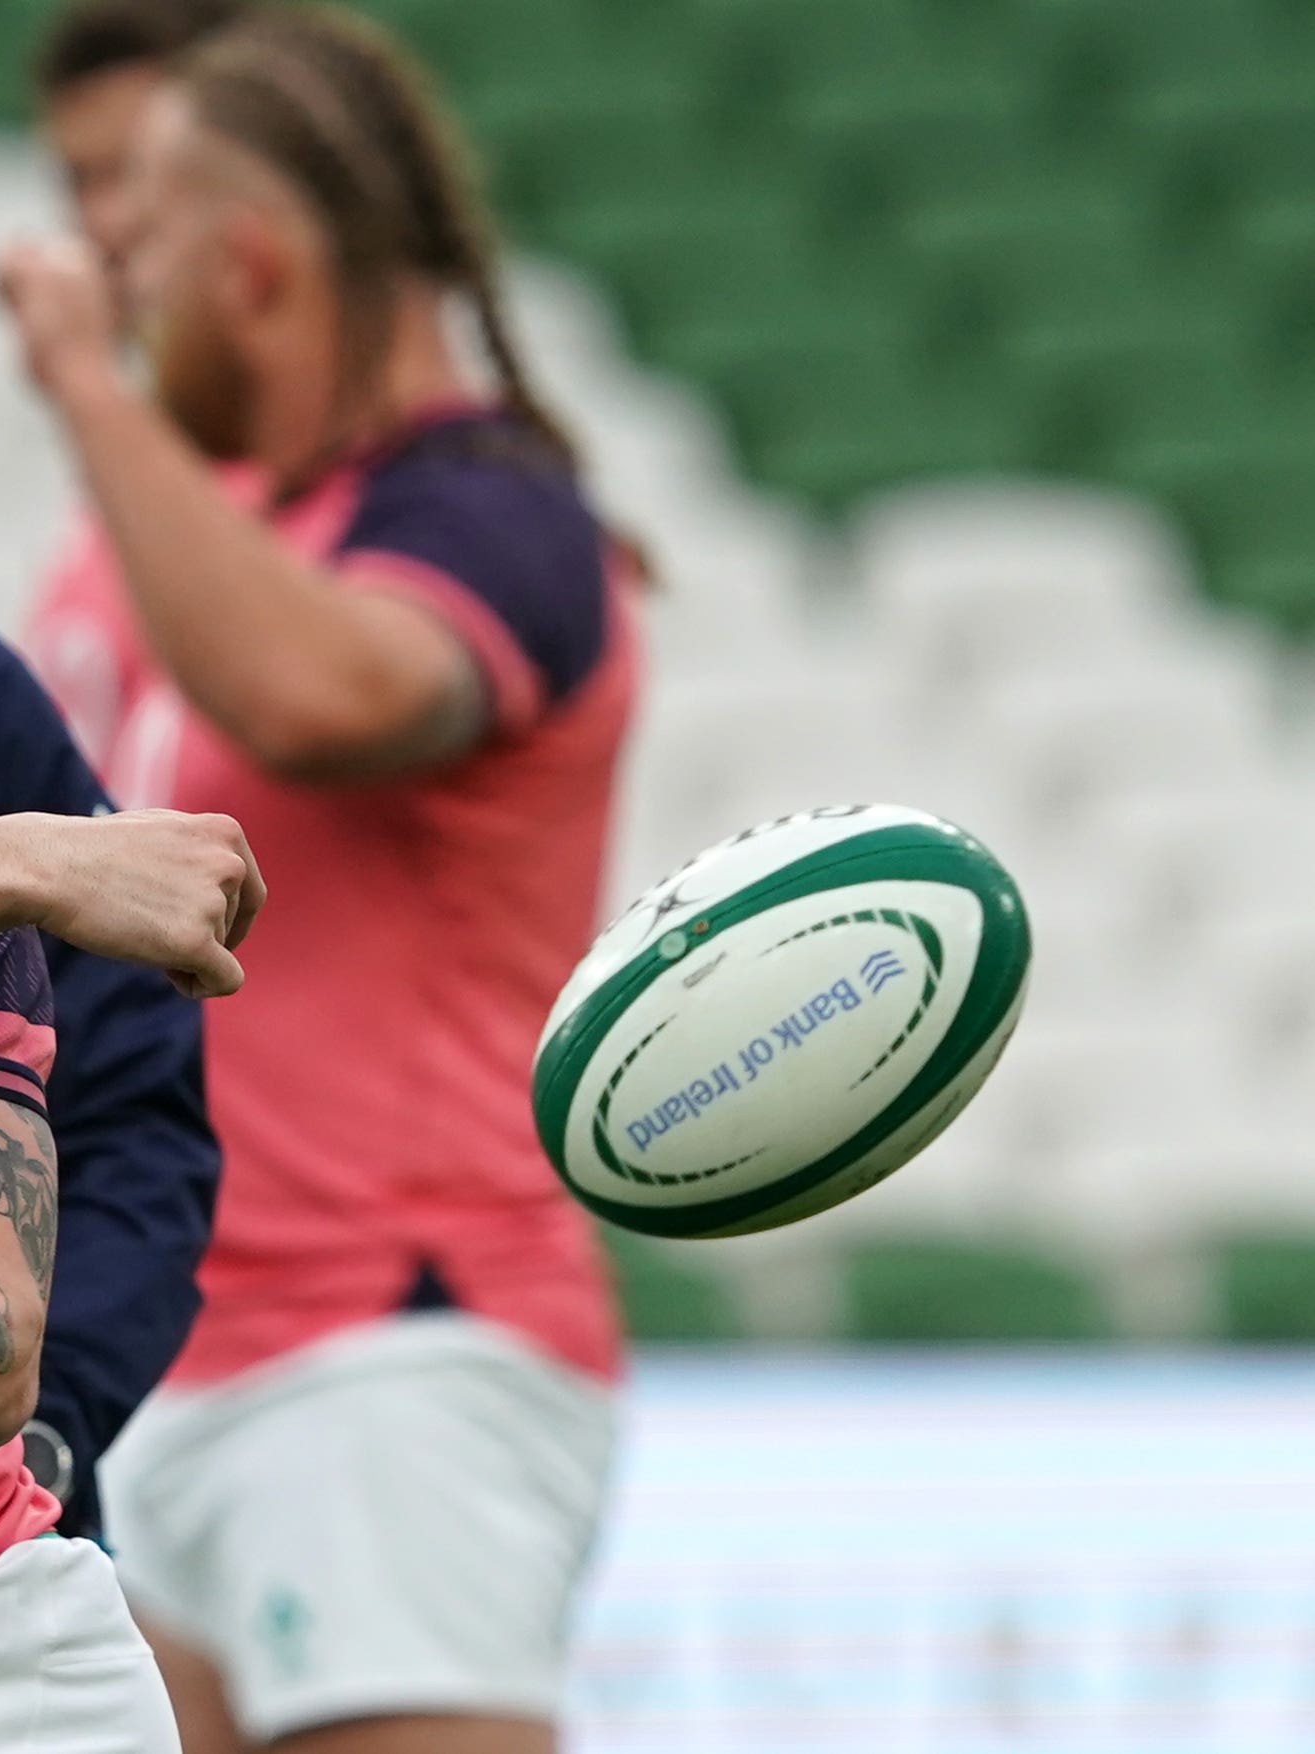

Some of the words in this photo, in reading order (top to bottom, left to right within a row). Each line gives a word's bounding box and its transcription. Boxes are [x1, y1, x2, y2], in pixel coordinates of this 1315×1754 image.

[770, 977, 862, 1050] Bank
[737, 1036, 774, 1083] of
[626, 1063, 742, 1153] Ireland
